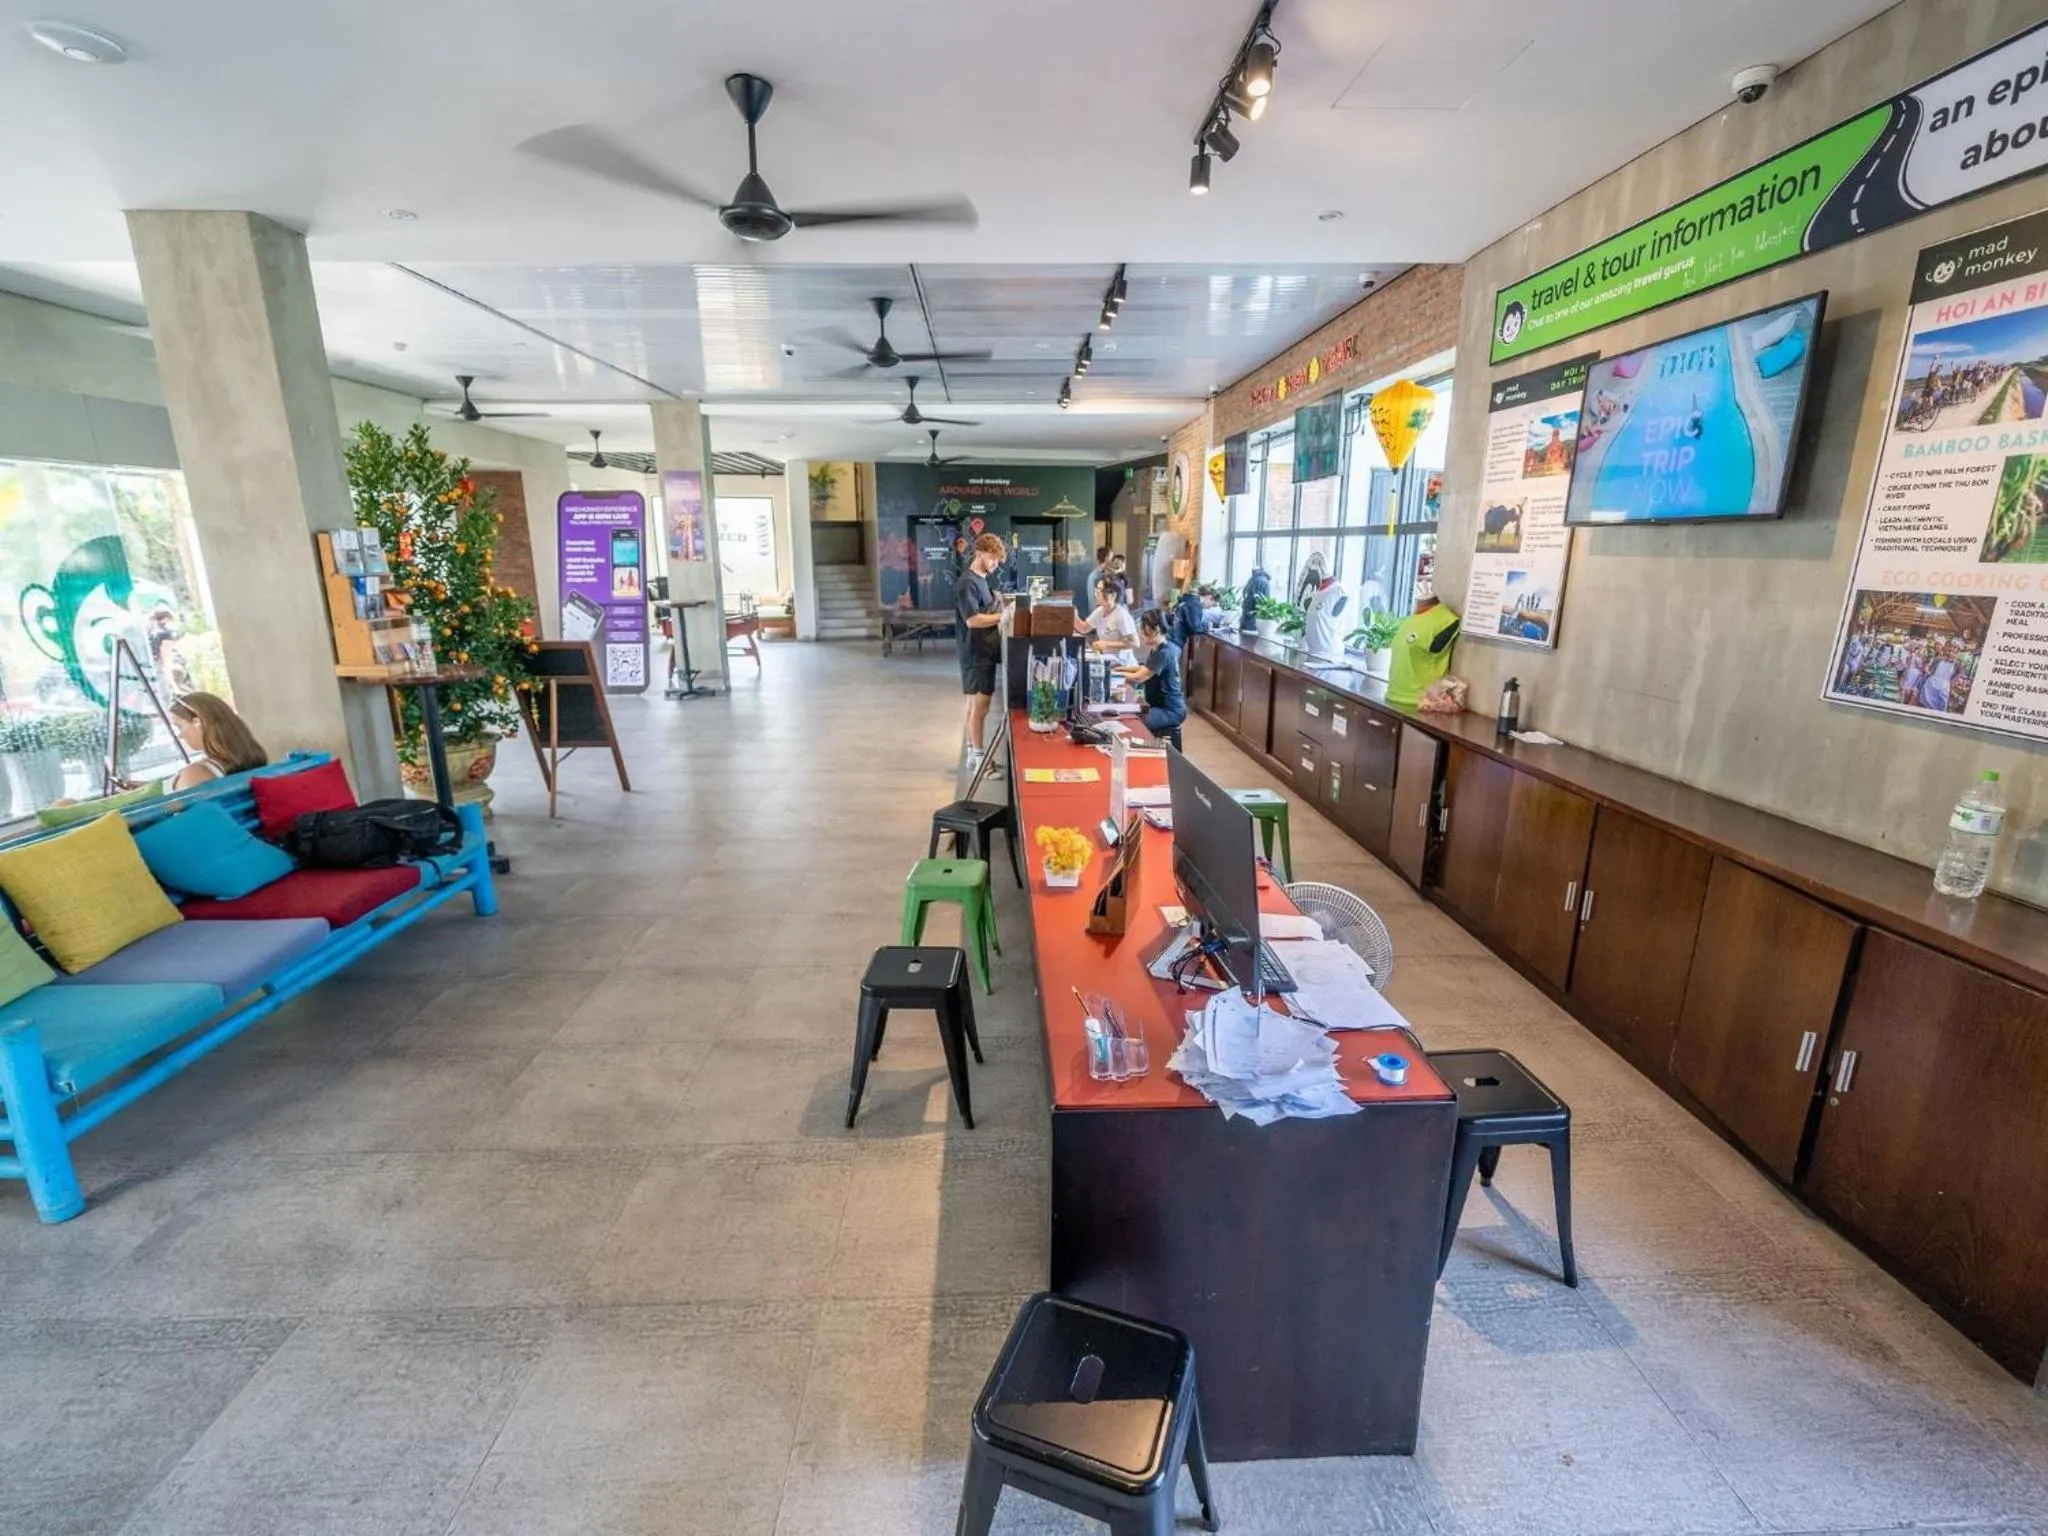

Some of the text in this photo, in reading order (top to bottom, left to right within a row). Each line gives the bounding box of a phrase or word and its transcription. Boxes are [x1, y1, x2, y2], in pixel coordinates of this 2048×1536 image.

[1929, 94, 1975, 133] an
[1531, 164, 1821, 311] travel & tour information
[1968, 236, 2009, 260] mad
[1965, 247, 2038, 277] monkey
[1554, 308, 1569, 320] one
[1579, 298, 1594, 310] our
[1594, 282, 1632, 305] amazing
[1634, 269, 1662, 289] travel
[1664, 256, 1696, 281] gurus
[1936, 299, 1976, 324] HOI
[1983, 289, 2016, 313] AN
[1564, 367, 1578, 378] HOI
[1645, 411, 1703, 443] EPIC
[1904, 436, 1990, 458] BAMBOO
[1641, 447, 1695, 478] TRIP
[1966, 465, 1997, 473] FOREST
[939, 484, 1039, 496] AROUND THE WORLD
[1882, 570, 1920, 586] ECO
[1926, 571, 2030, 591] COOKING
[2011, 600, 2036, 608] COOK
[1998, 646, 2025, 654] LOCAL
[1994, 658, 2026, 668] SELECT
[1992, 667, 2048, 680] INGREDIENTS
[1986, 688, 2015, 698] CRUISE
[1988, 680, 2024, 692] BAMBOO
[1980, 710, 2002, 720] YOUR
[1982, 701, 2047, 718] END THE CLASS
